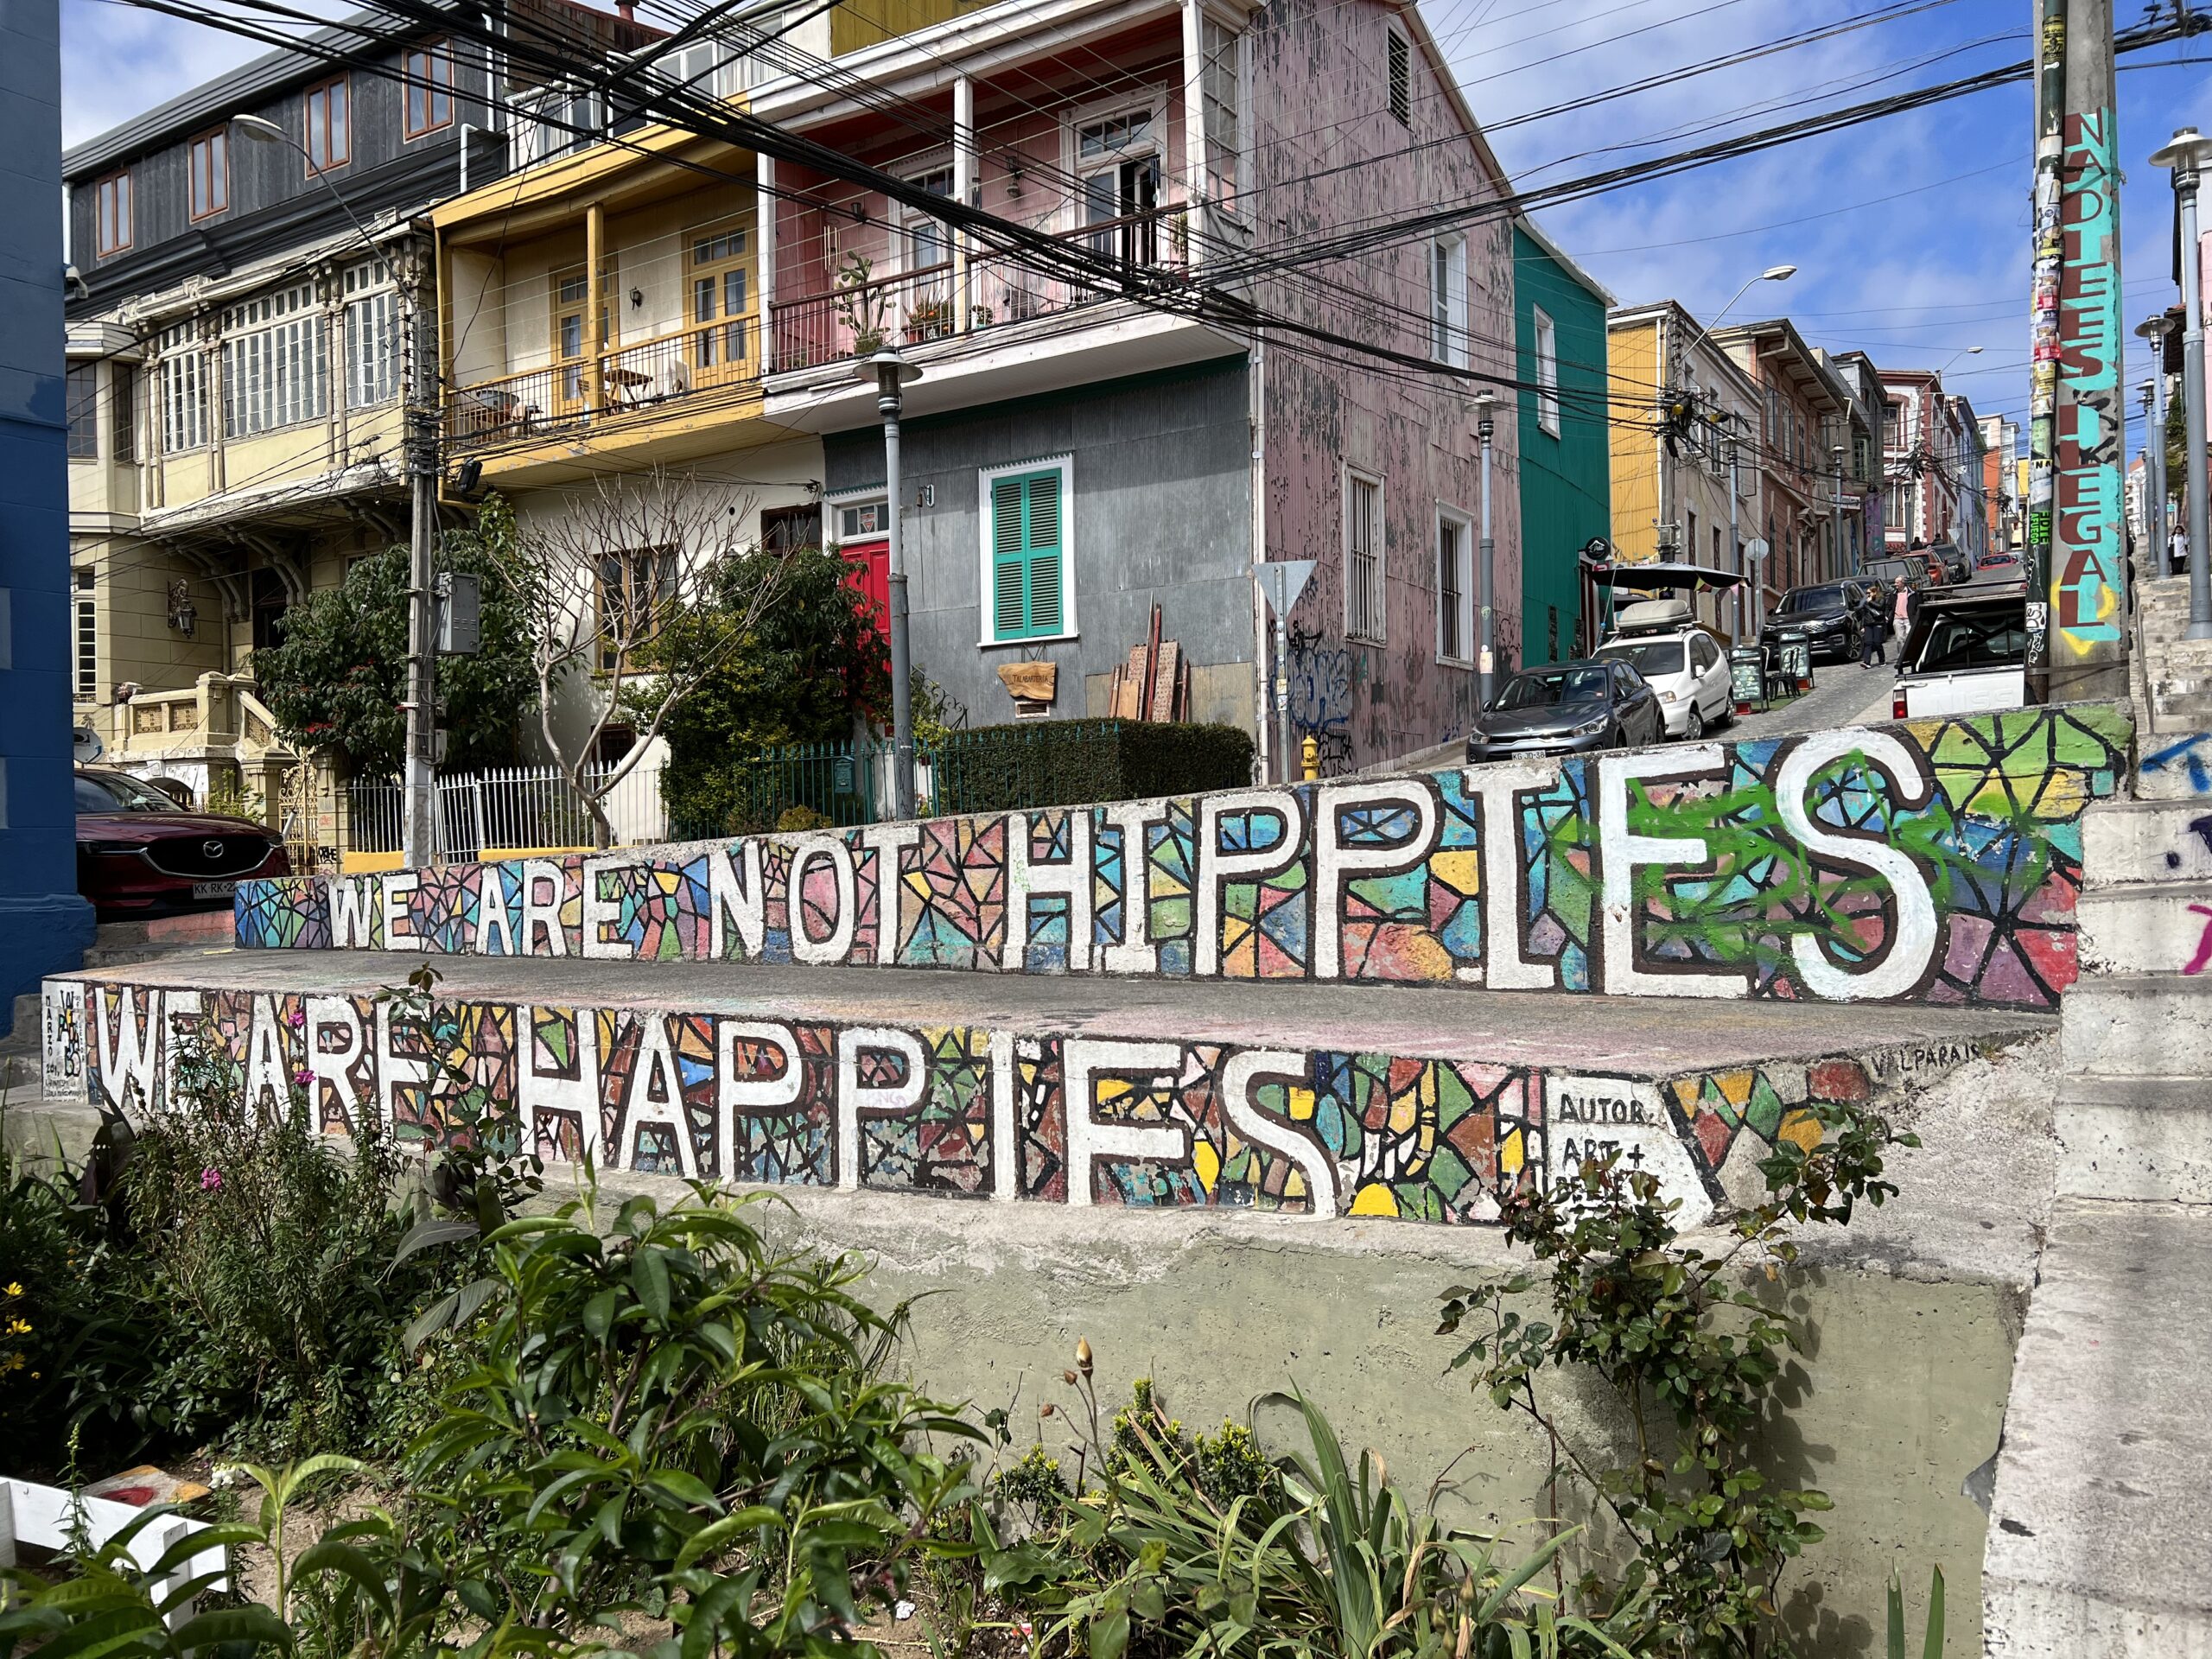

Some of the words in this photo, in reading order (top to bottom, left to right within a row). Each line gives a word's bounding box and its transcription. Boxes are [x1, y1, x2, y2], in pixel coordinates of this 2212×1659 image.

[2059, 404, 2107, 628] ILEGAL
[328, 869, 419, 953] WE
[475, 858, 635, 960] ARE
[709, 825, 922, 970] NOT
[1001, 726, 1937, 1003] HIPPIES
[518, 1003, 1337, 1222] HAPPIES
